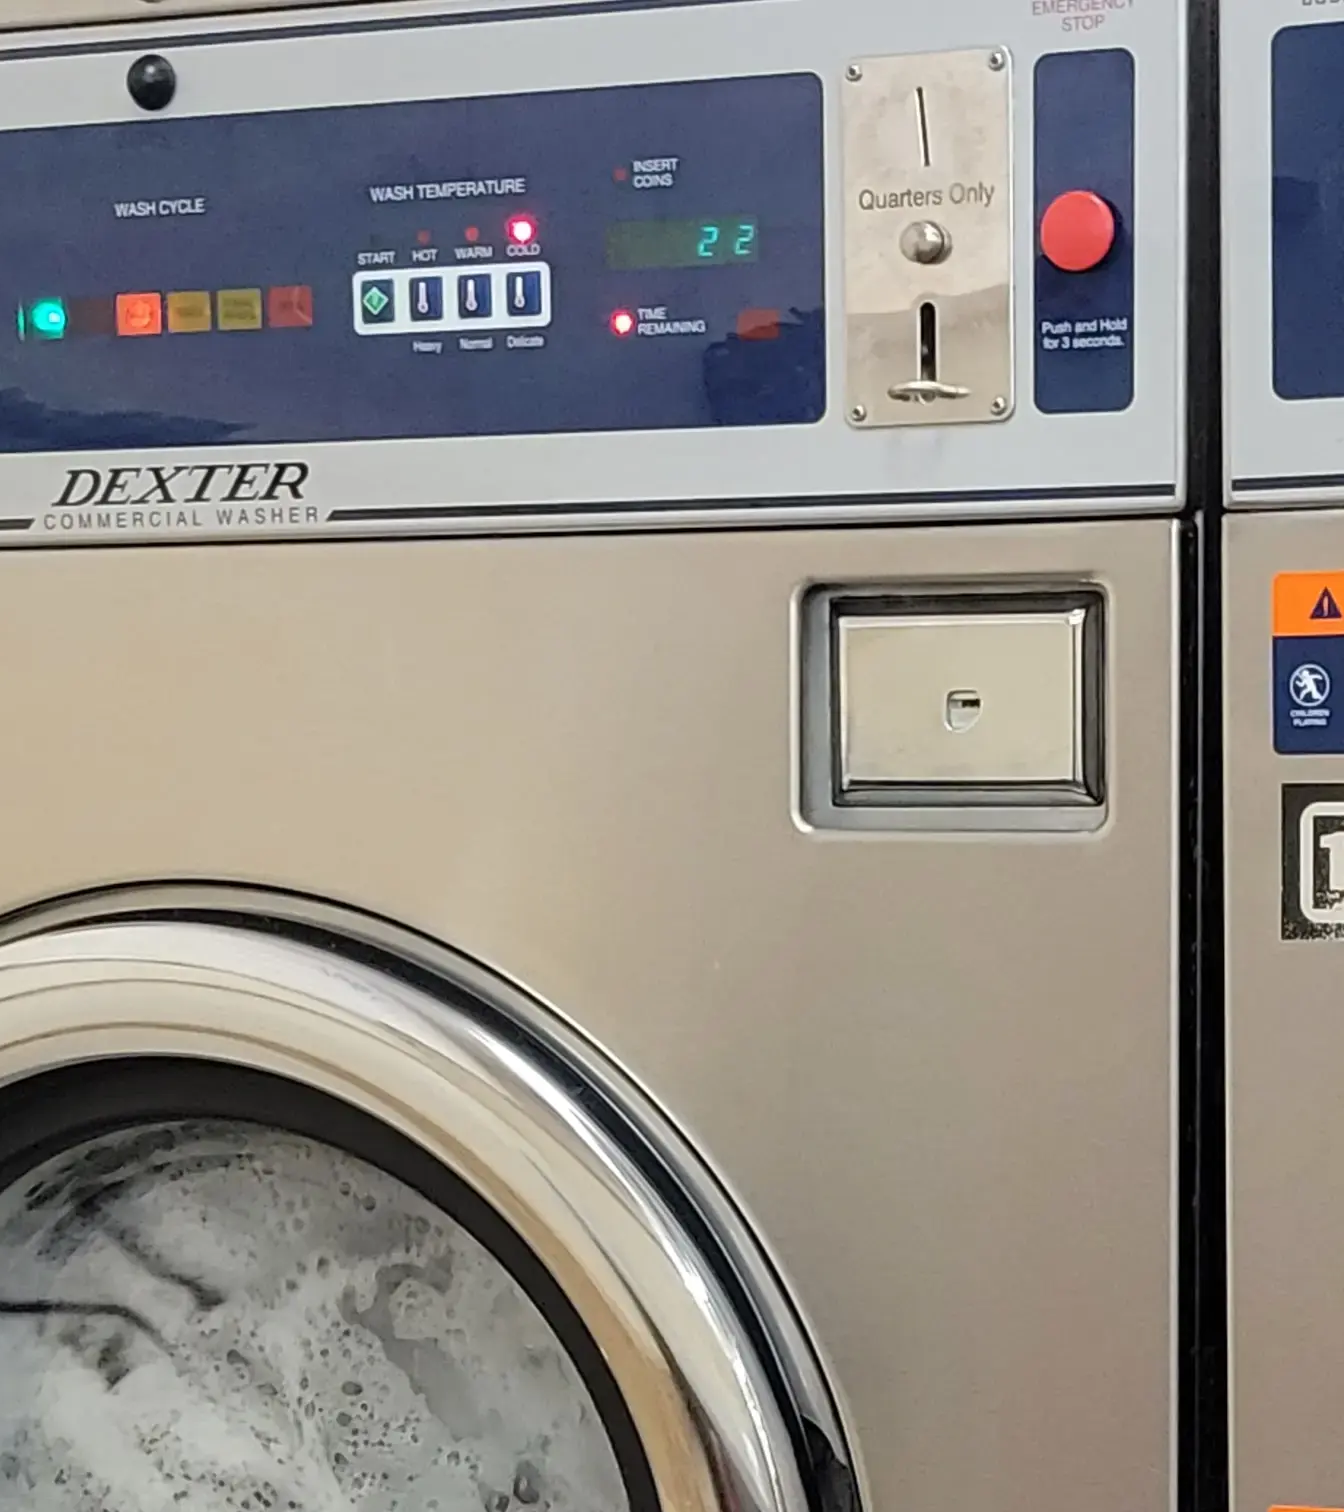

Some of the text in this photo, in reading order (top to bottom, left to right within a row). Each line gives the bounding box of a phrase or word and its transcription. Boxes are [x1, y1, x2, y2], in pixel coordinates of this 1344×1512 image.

[1061, 14, 1105, 32] STOP
[632, 158, 680, 173] INSERT
[632, 173, 674, 188] COINS
[370, 177, 527, 203] WASH TEMPERATURE
[858, 182, 996, 211] Quarters Only
[114, 197, 206, 218] WASH CYCLE
[412, 248, 438, 262] HOT
[454, 245, 493, 260] WARM
[506, 243, 541, 257] COLD
[357, 251, 396, 266] START
[637, 306, 668, 320] TIME
[637, 320, 706, 336] REMAINING
[1041, 317, 1128, 334] Push and Hold
[1042, 335, 1060, 350] for
[1061, 335, 1071, 349] 3
[51, 461, 309, 508] DEXTER
[43, 506, 319, 531] COMMERCIAL WASHER
